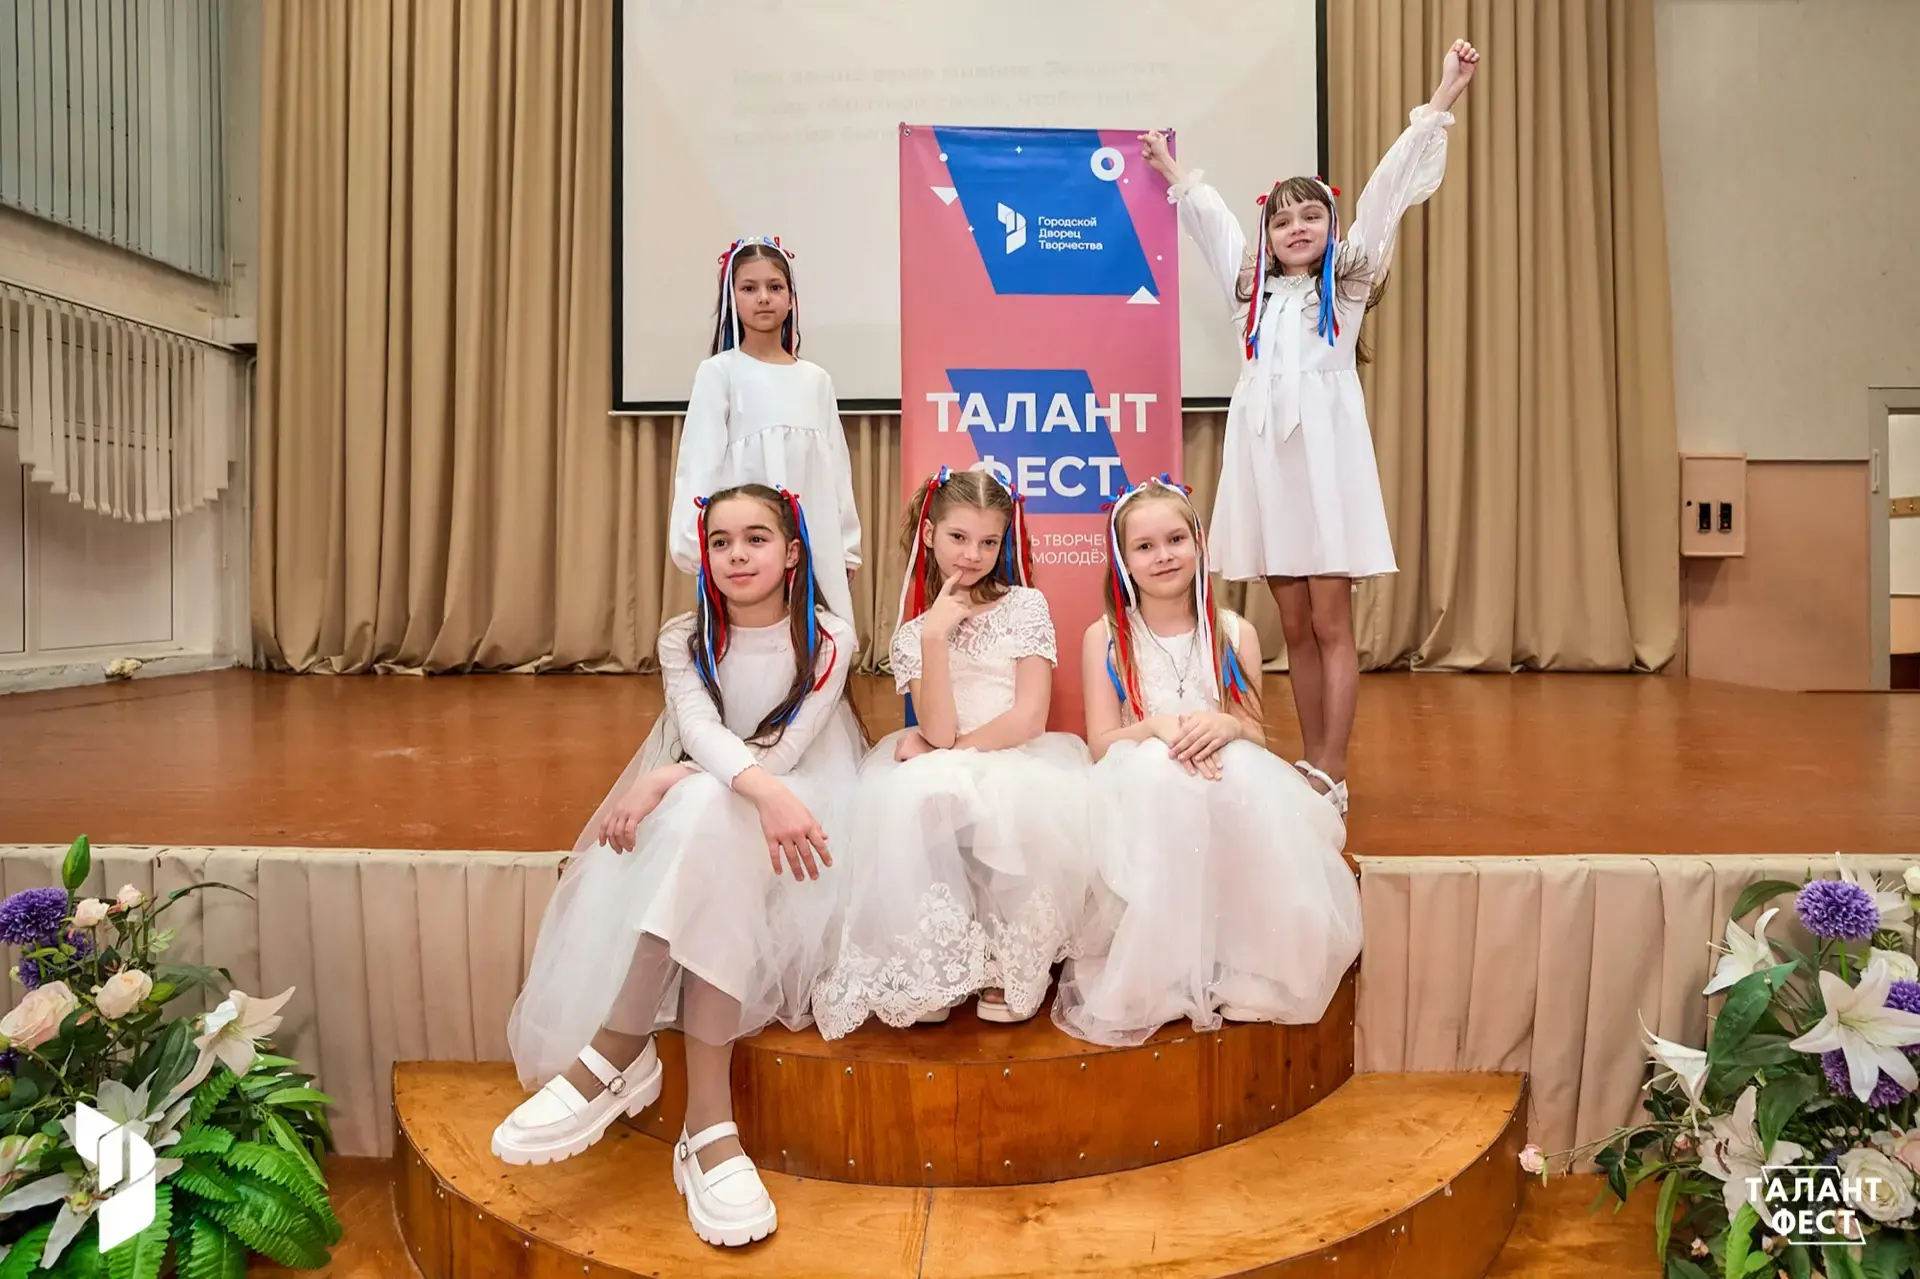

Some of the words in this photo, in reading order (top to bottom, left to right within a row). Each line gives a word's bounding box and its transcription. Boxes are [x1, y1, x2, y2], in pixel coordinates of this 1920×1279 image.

[1038, 216, 1097, 228] Городской
[1038, 228, 1081, 240] Дворец
[1038, 240, 1103, 252] Творчества
[926, 393, 1157, 432] ТАЛАНТ
[968, 455, 1121, 497] ФЕСТ
